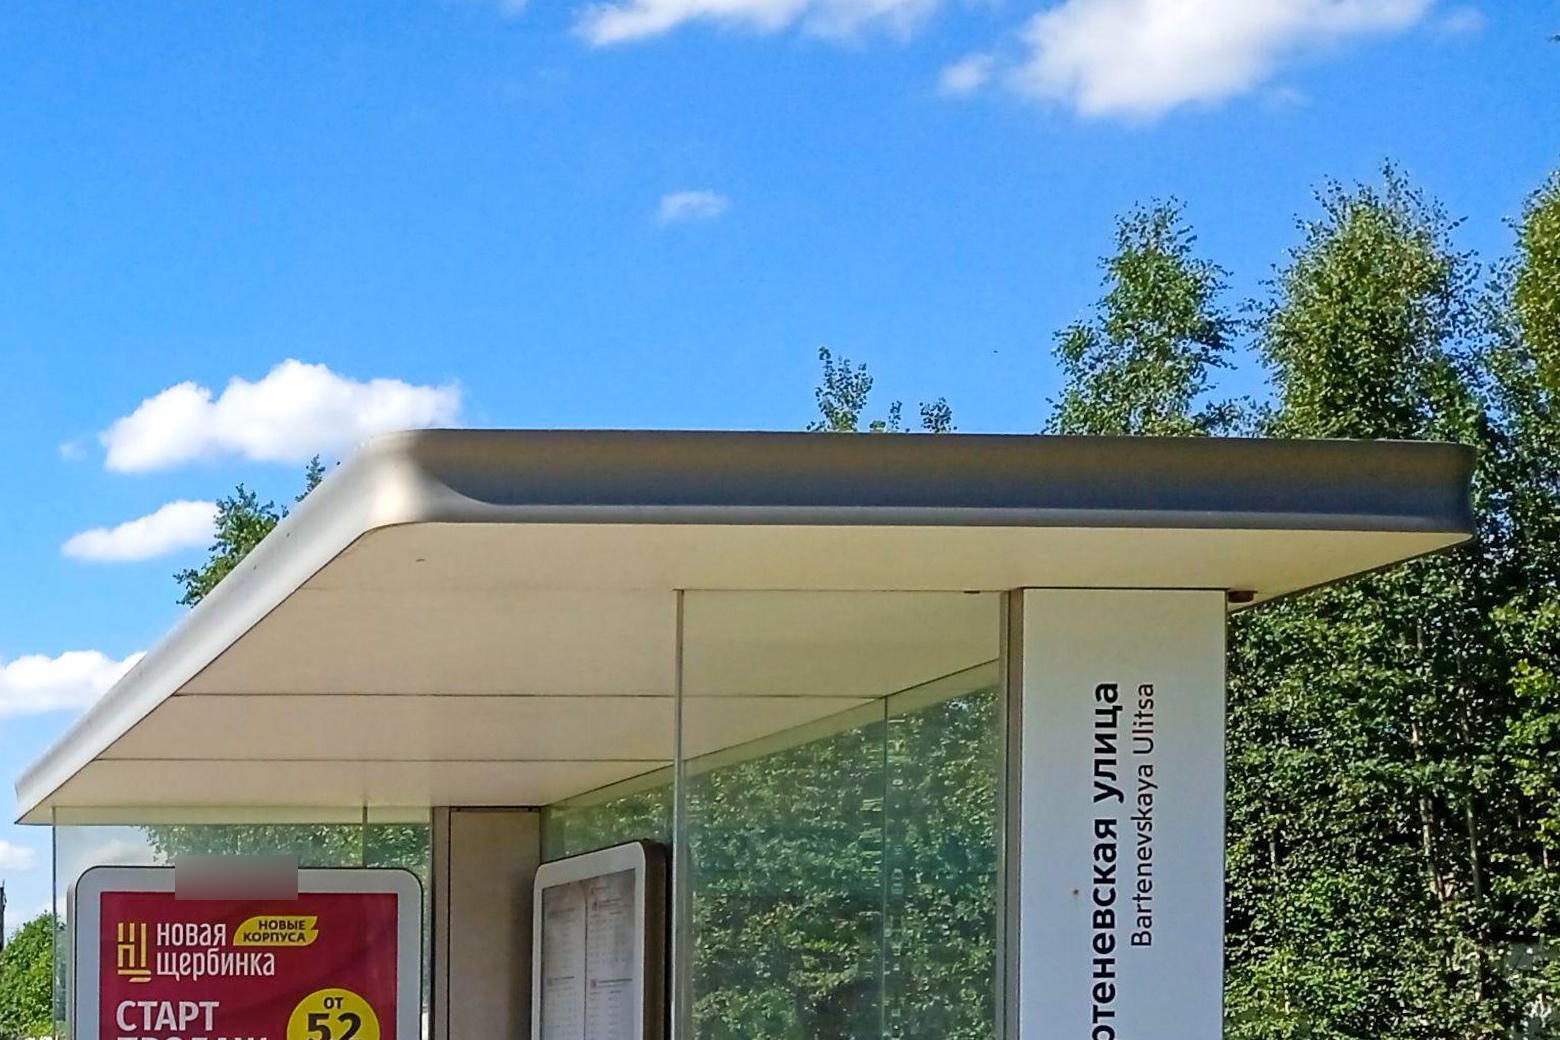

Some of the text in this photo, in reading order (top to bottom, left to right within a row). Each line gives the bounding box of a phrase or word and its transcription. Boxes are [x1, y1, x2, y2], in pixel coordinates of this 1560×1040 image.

[1092, 682, 1125, 804] улица
[1131, 683, 1158, 947] Bartenevskaya Ulitsa
[243, 932, 306, 942] КОРПУСА
[258, 919, 306, 930] НОВЫЕ
[116, 1000, 220, 1032] СТАРТ
